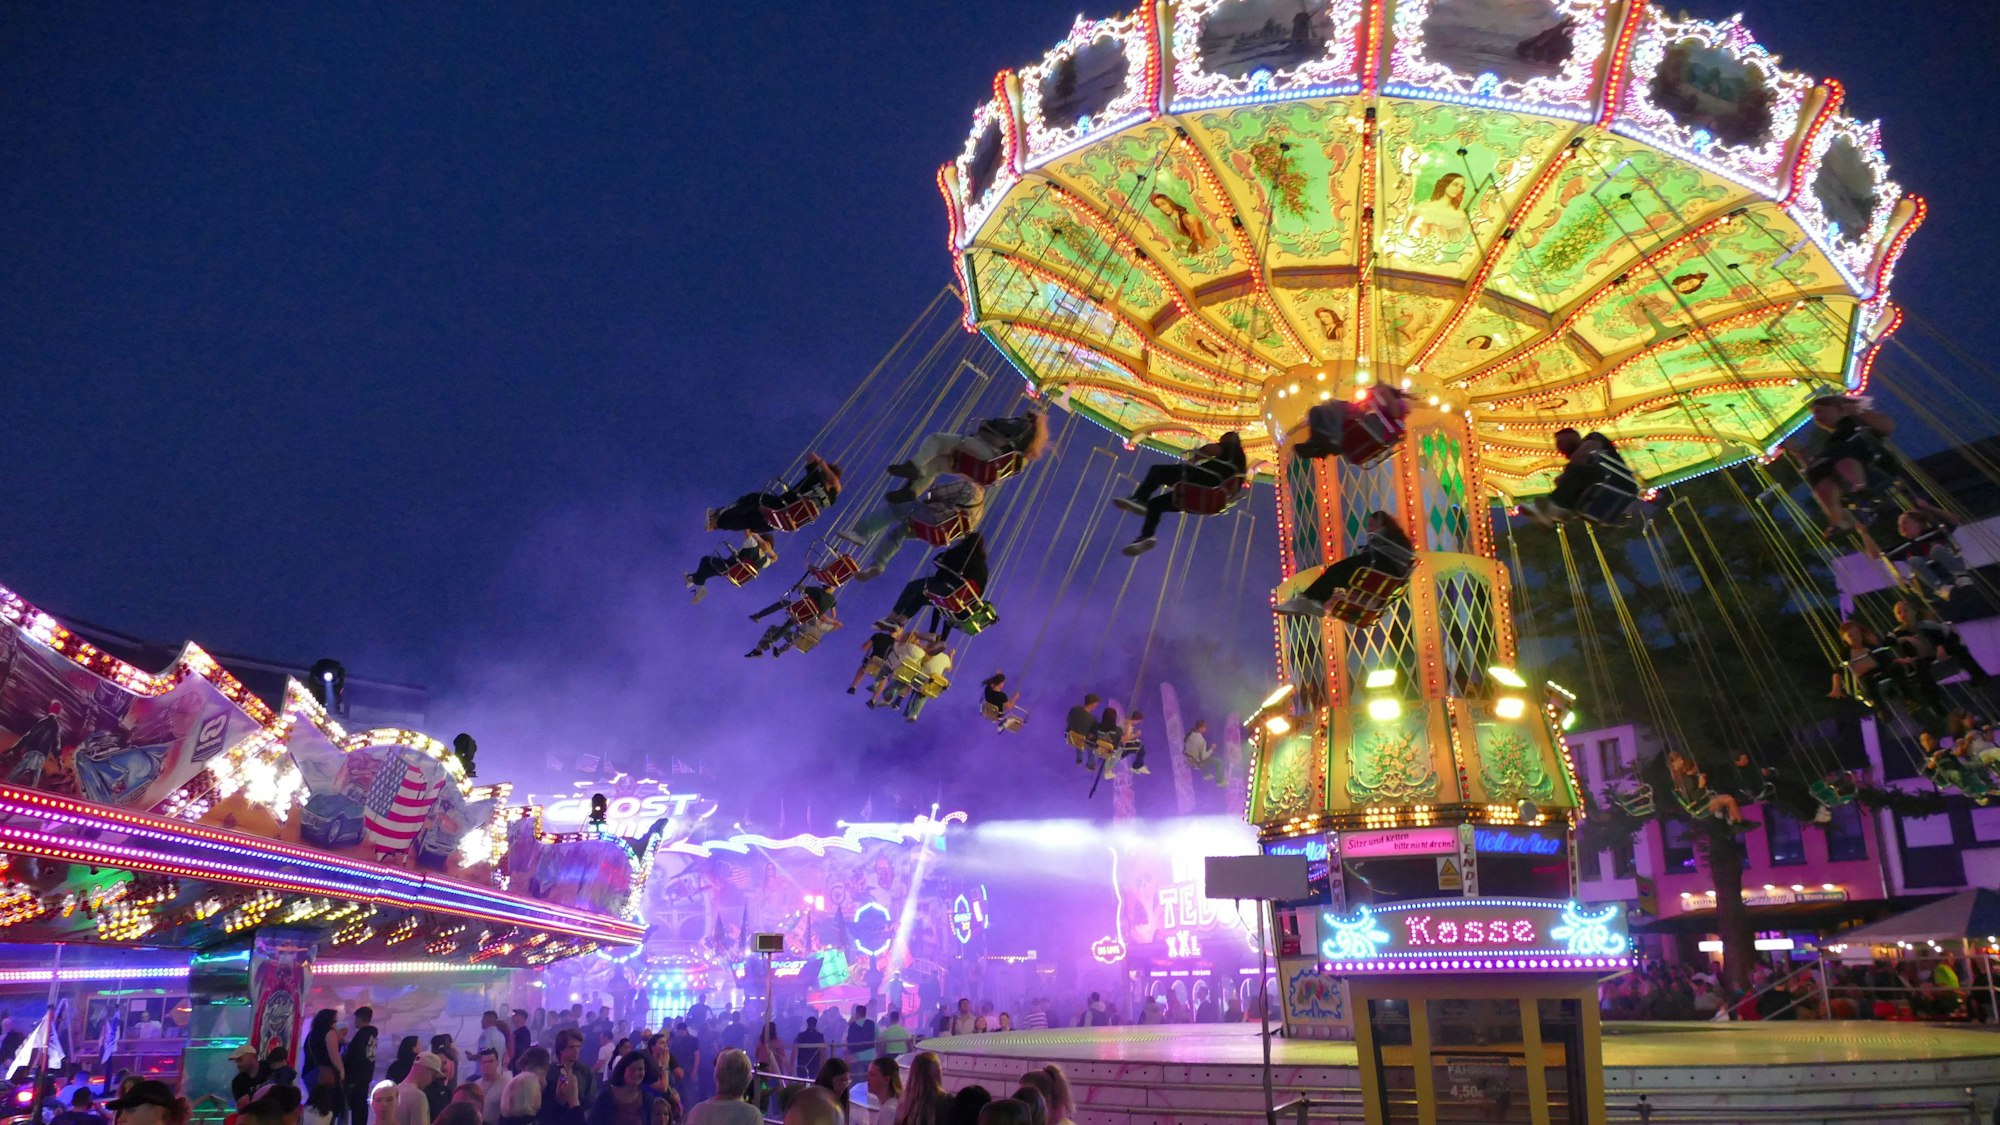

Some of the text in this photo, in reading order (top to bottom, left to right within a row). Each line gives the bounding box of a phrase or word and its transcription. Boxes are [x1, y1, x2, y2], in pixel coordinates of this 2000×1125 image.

[1348, 832, 1410, 850] Sitze und Ketten
[1393, 841, 1410, 850] bitte
[1410, 840, 1428, 849] nicht
[1405, 915, 1536, 944] Kasse
[1165, 930, 1202, 958] XXL
